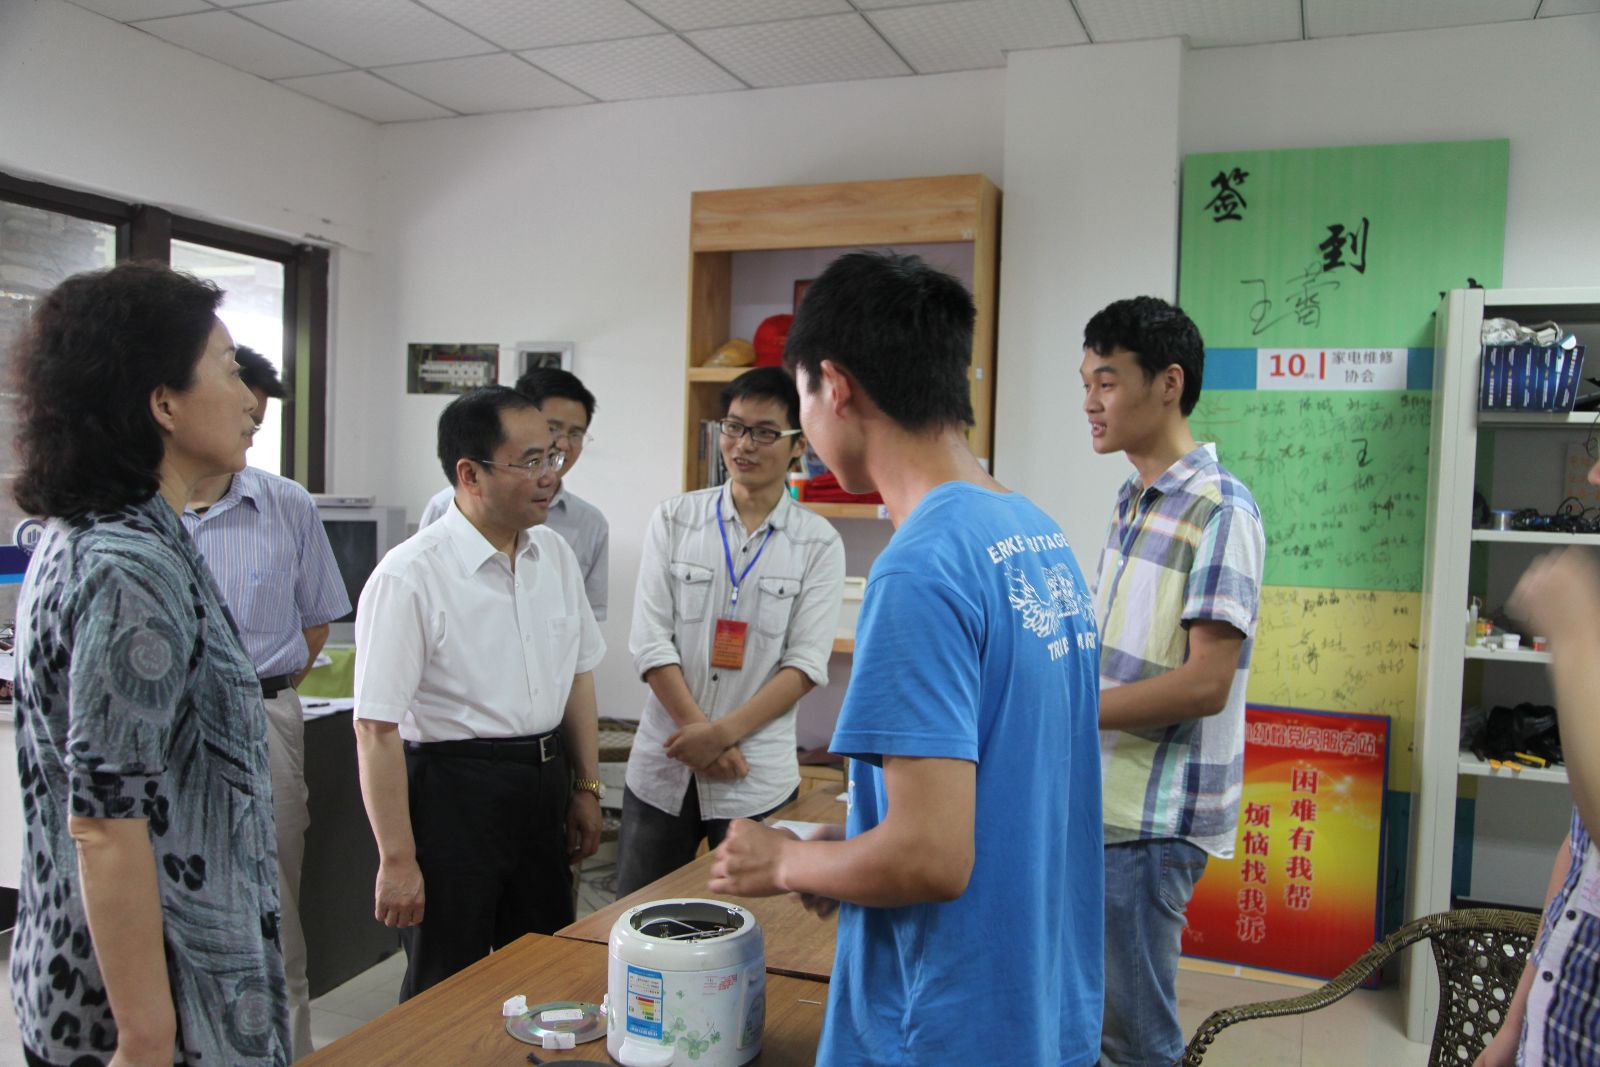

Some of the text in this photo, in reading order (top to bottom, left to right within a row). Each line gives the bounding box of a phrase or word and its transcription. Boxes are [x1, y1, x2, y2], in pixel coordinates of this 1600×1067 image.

[1270, 353, 1306, 377] 10
[1332, 351, 1393, 365] 家电维修
[1345, 369, 1375, 383] 协会
[987, 535, 1026, 565] ERKE
[1285, 767, 1319, 911] 困难有我帮
[1236, 802, 1271, 943] 烦恼找我诉
